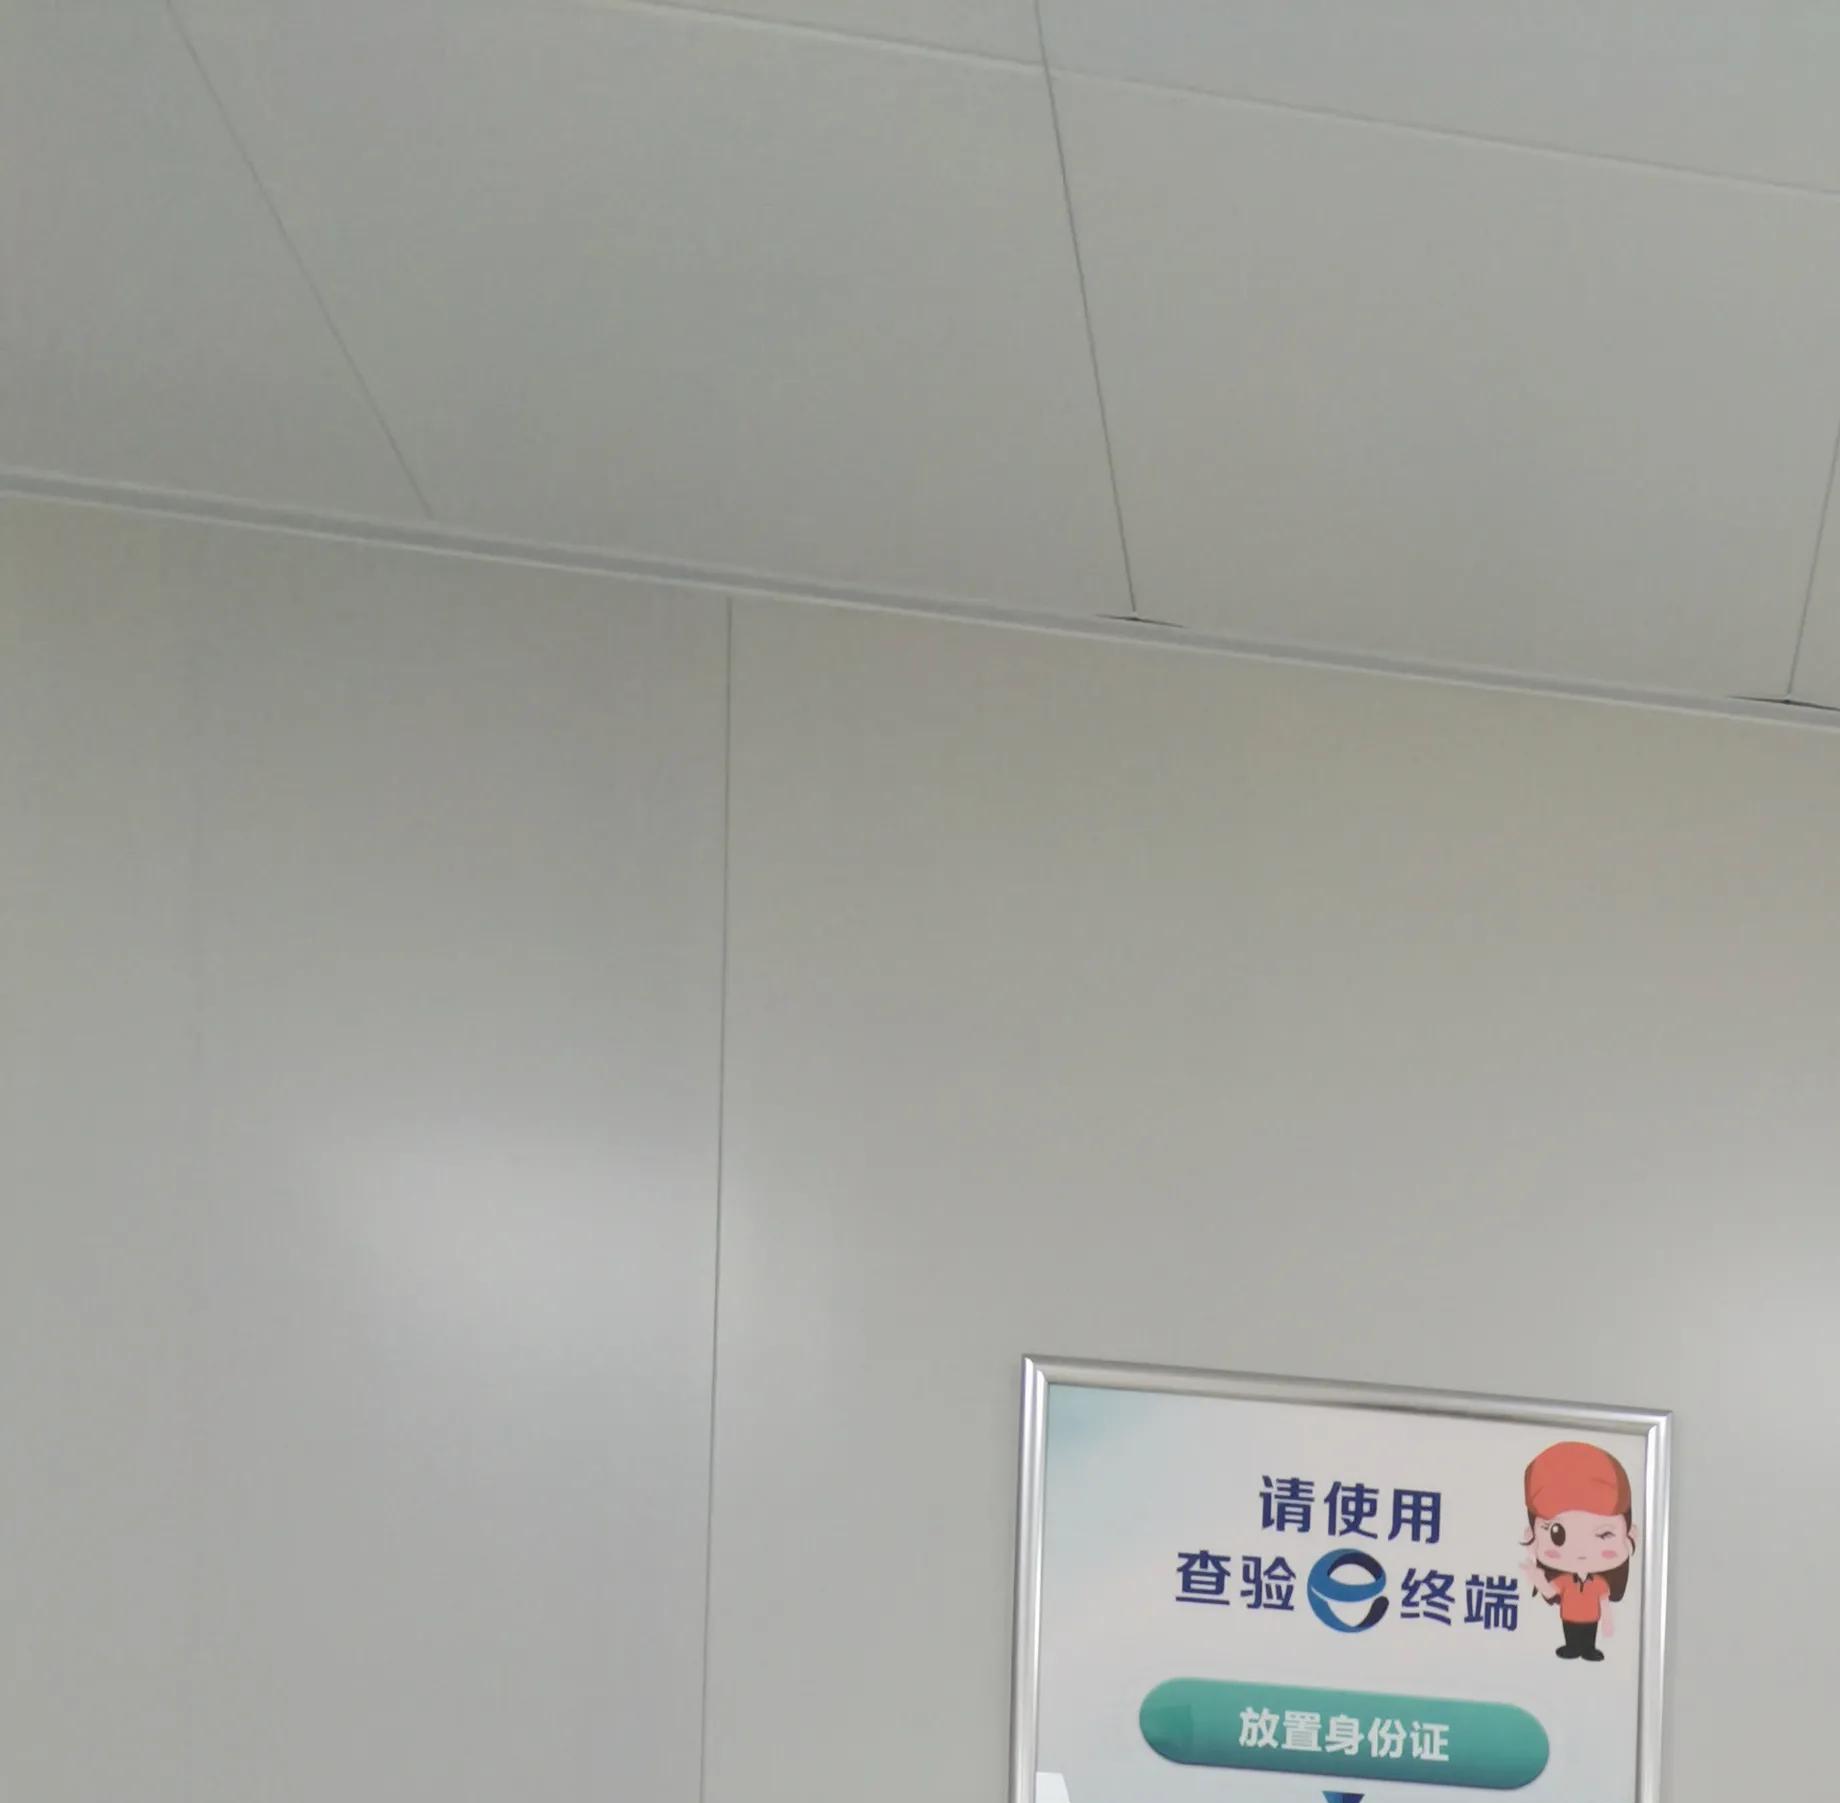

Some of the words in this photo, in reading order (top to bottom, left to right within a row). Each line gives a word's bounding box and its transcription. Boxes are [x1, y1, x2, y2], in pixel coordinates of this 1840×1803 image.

[1260, 1475, 1442, 1544] 请使用
[1238, 1706, 1450, 1762] 放置身份证
